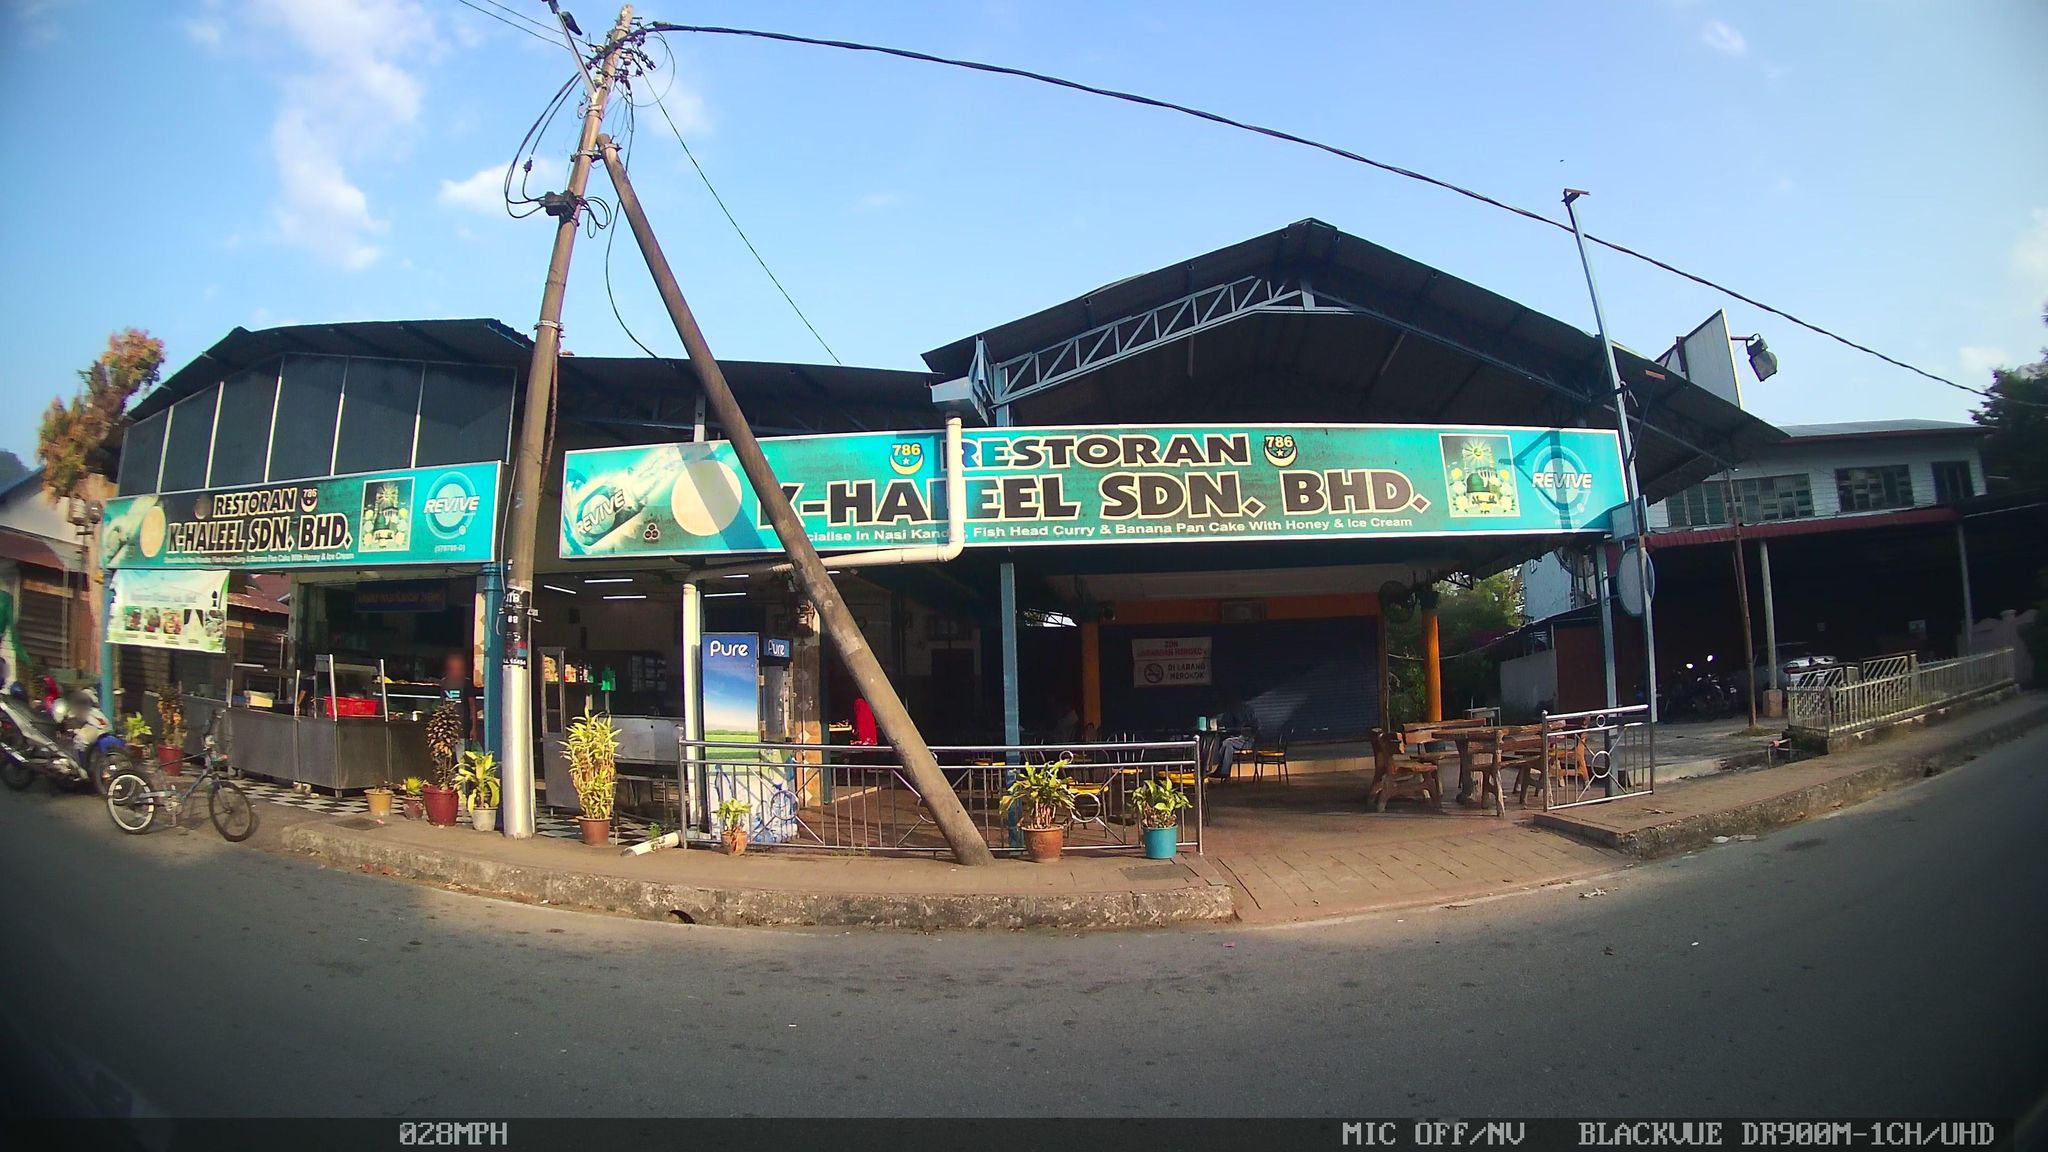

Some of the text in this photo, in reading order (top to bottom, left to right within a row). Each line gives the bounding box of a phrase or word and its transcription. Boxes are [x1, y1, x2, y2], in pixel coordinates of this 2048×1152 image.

[892, 443, 921, 457] 786
[940, 433, 1251, 470] RESTORAN
[1265, 436, 1293, 448] 786
[1532, 472, 1593, 489] REVIVE
[213, 487, 297, 518] RESTORAN
[424, 495, 480, 514] REVIVE
[1099, 471, 1266, 519] SDN.
[1280, 469, 1431, 514] BHD.
[577, 488, 625, 534] REVIVE
[166, 513, 353, 554] K-HALEEL SDN. BHD.
[806, 530, 851, 542] cialise
[856, 530, 870, 541] In
[874, 529, 906, 541] Nasi
[973, 526, 1005, 537] Fish
[1010, 525, 1048, 536] Head
[1053, 525, 1095, 537] Curry
[1100, 524, 1112, 534] &
[1115, 523, 1172, 534] Banana
[1176, 523, 1204, 533] Pan
[1209, 521, 1245, 532] Cake
[1249, 520, 1281, 531] With
[1286, 519, 1330, 532] Honey
[1334, 518, 1344, 528] &
[1348, 518, 1366, 528] Ice
[1371, 517, 1412, 528] Cream
[710, 640, 749, 657] Pure
[768, 639, 785, 656] Pure
